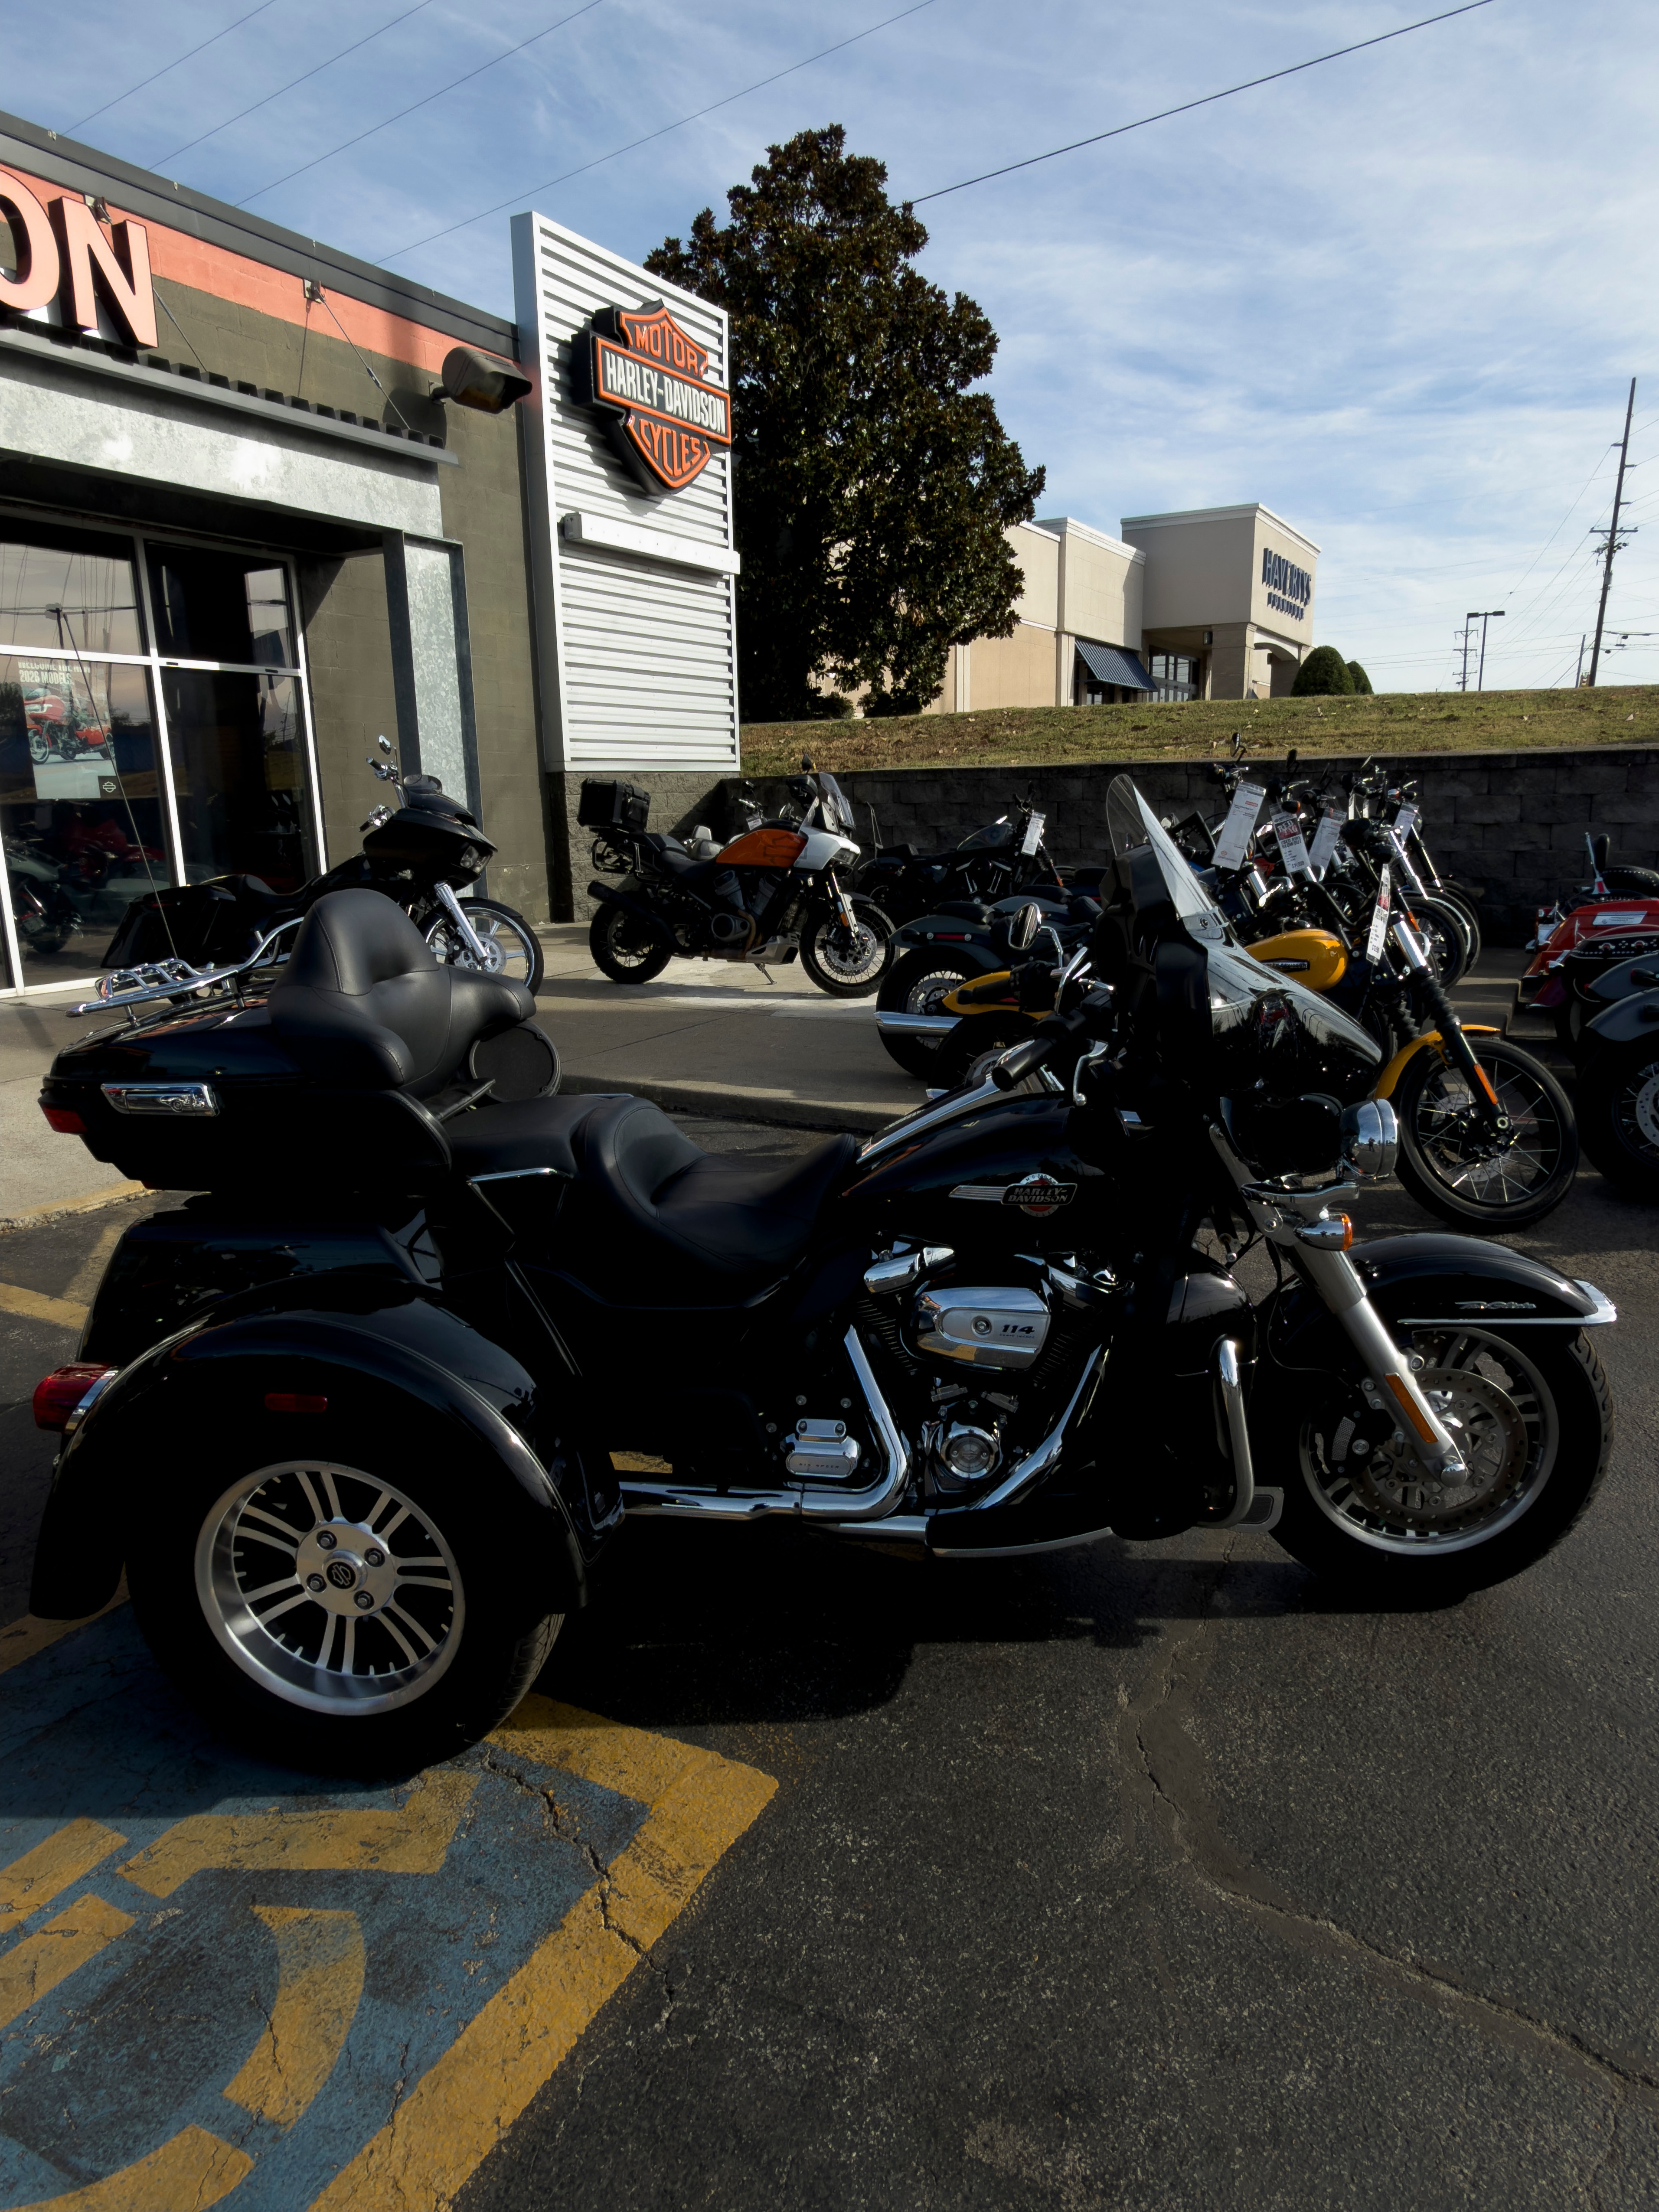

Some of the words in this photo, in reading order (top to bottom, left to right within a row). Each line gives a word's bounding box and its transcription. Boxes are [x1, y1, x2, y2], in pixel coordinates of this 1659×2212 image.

[634, 320, 698, 376] MOTOR
[605, 351, 726, 434] HARLEY-DAVIDSON
[639, 418, 701, 477] CYCLES
[1262, 548, 1312, 607] HAVERTYS
[19, 670, 40, 683] 2026
[1002, 1325, 1035, 1334] 114
